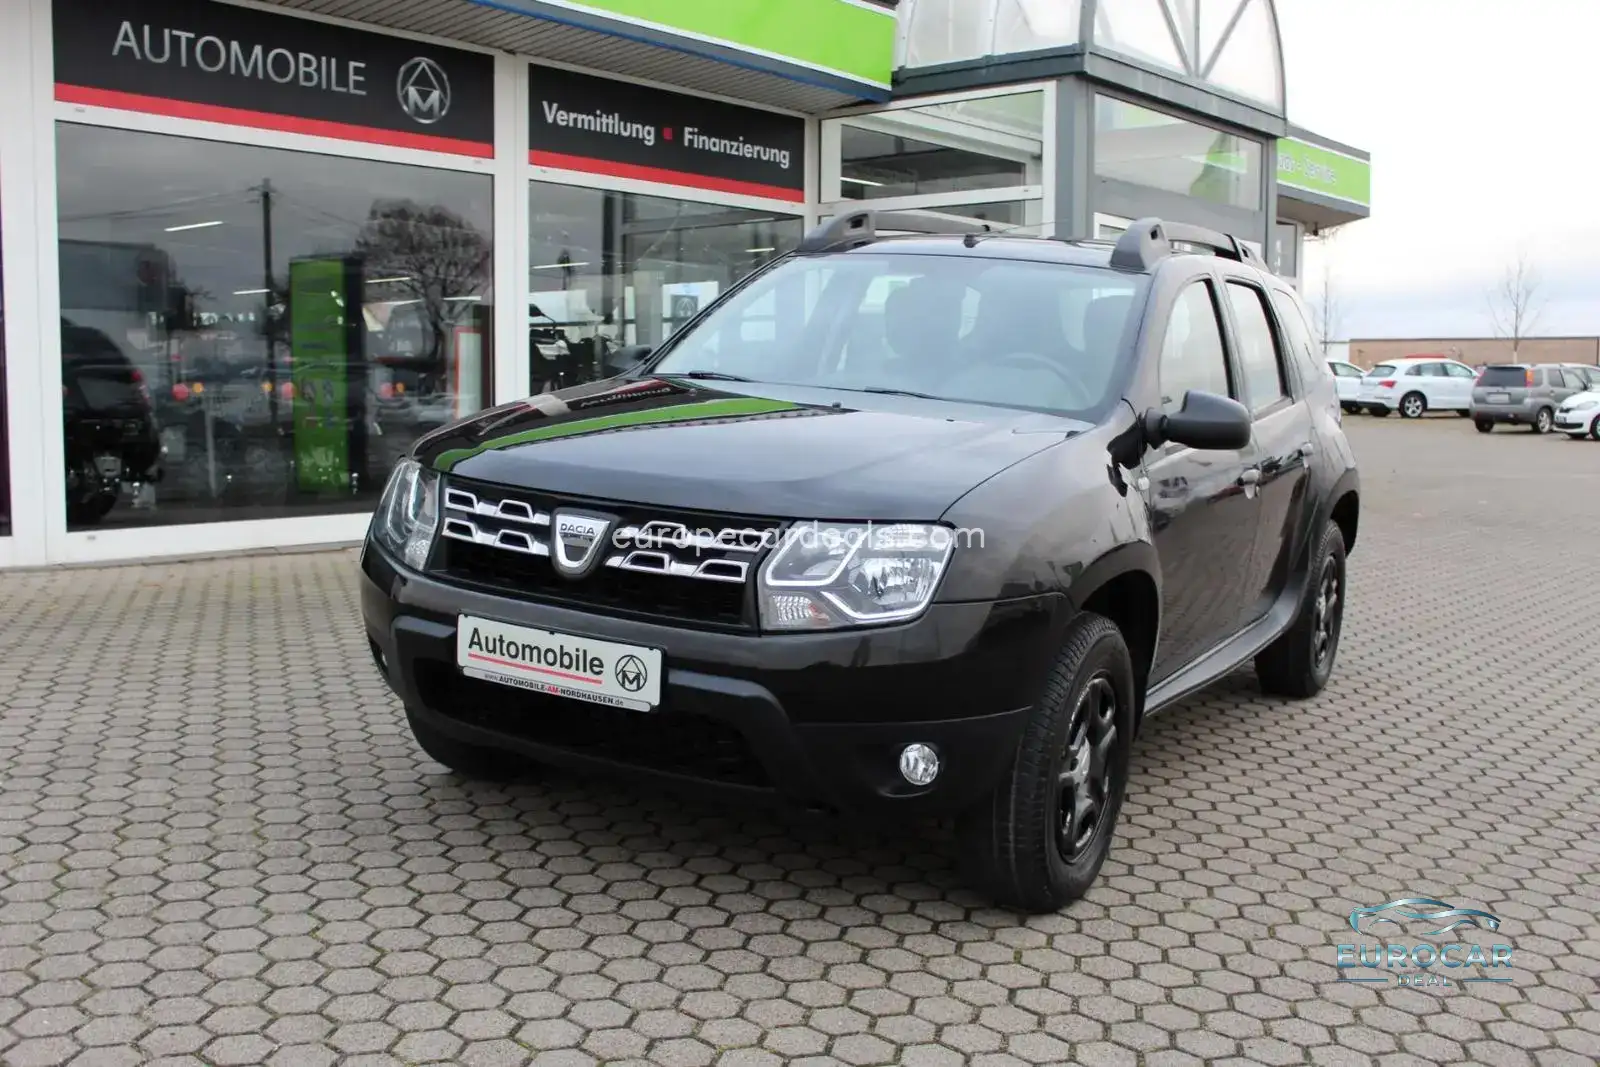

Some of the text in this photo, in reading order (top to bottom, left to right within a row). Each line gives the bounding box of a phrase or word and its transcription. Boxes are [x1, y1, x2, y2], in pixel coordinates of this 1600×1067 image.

[112, 21, 367, 96] AUTOMOBILE
[542, 101, 791, 169] Vermittlung Finanzierung
[560, 523, 595, 536] DACIA
[468, 627, 604, 676] Automobile
